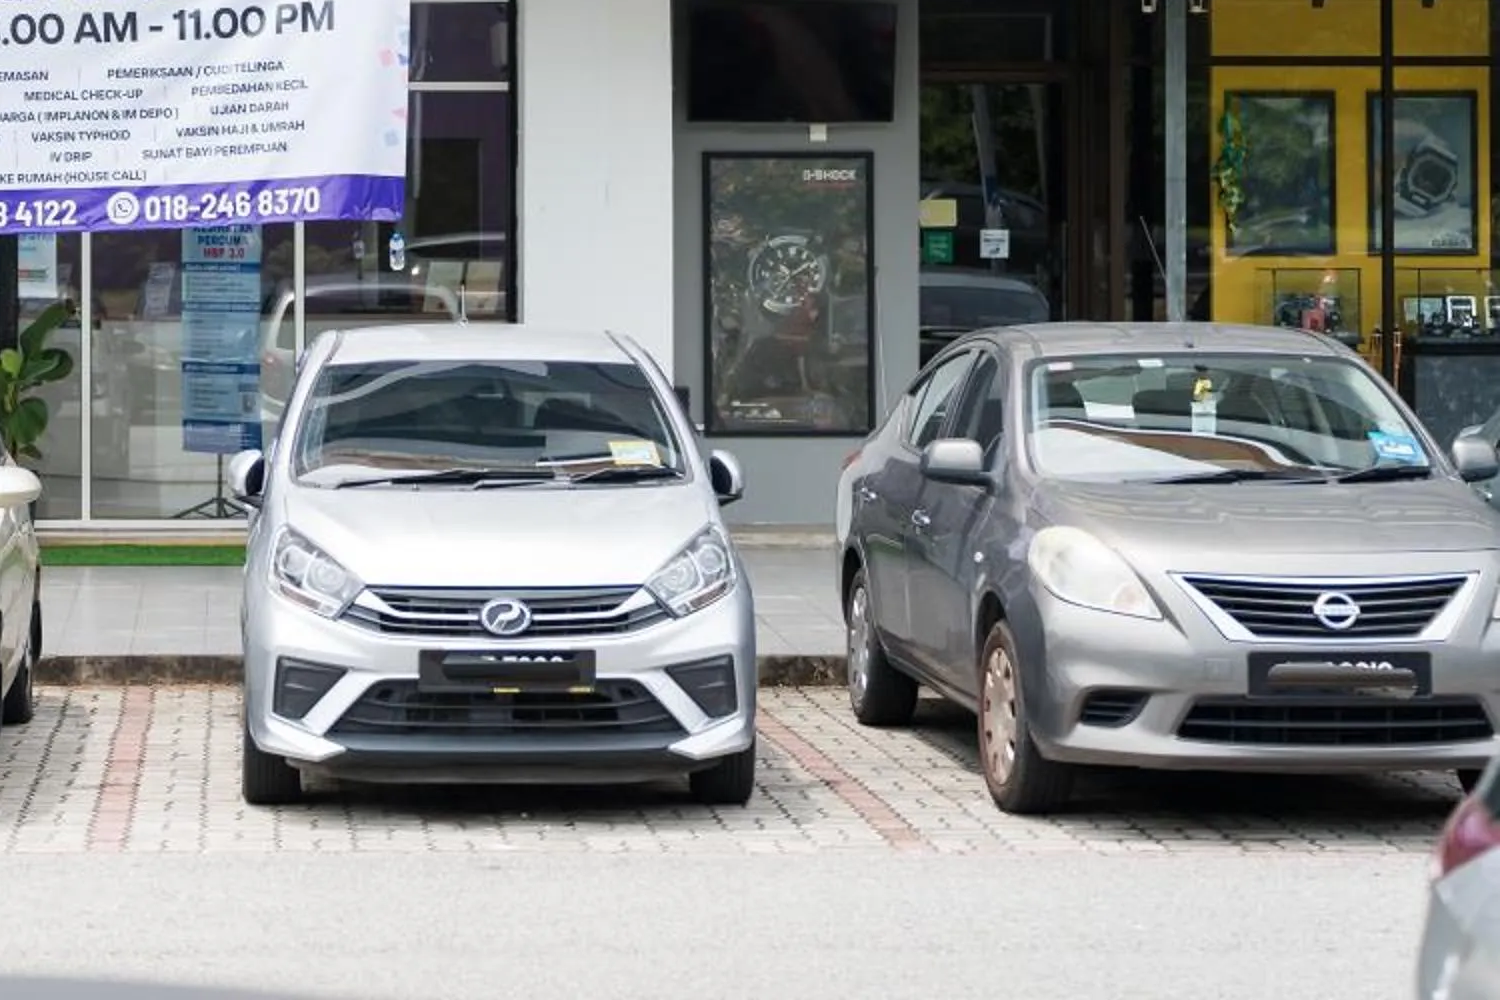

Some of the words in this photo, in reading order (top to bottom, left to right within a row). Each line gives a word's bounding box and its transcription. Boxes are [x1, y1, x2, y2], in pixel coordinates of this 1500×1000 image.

[74, 11, 139, 44] AM
[173, 6, 267, 41] 11.00
[275, 0, 335, 34] PM
[107, 66, 193, 79] PEMERIKSAAN
[232, 60, 285, 75] TELINGA
[276, 79, 308, 92] KECIL
[24, 89, 78, 102] MEDICAL
[81, 88, 143, 101] CHECK-UP
[139, 107, 173, 119] DEPO
[210, 102, 247, 116] UJIAN
[249, 100, 289, 114] DARAH
[31, 130, 76, 143] VAKSIN
[78, 129, 131, 142] TYPHOID
[176, 125, 220, 138] VAKSIN
[222, 123, 249, 136] HAJI
[261, 120, 305, 133] UMRAH
[50, 151, 62, 163] IV
[64, 151, 92, 163] DRIP
[142, 148, 184, 161] SUNAT
[186, 145, 212, 159] BAYI
[214, 140, 288, 157] PEREMPUAN
[0, 172, 15, 184] KE
[17, 170, 62, 184] RUMAH
[15, 199, 78, 227] 4122
[144, 192, 253, 223] 018-246
[257, 187, 321, 217] 8370
